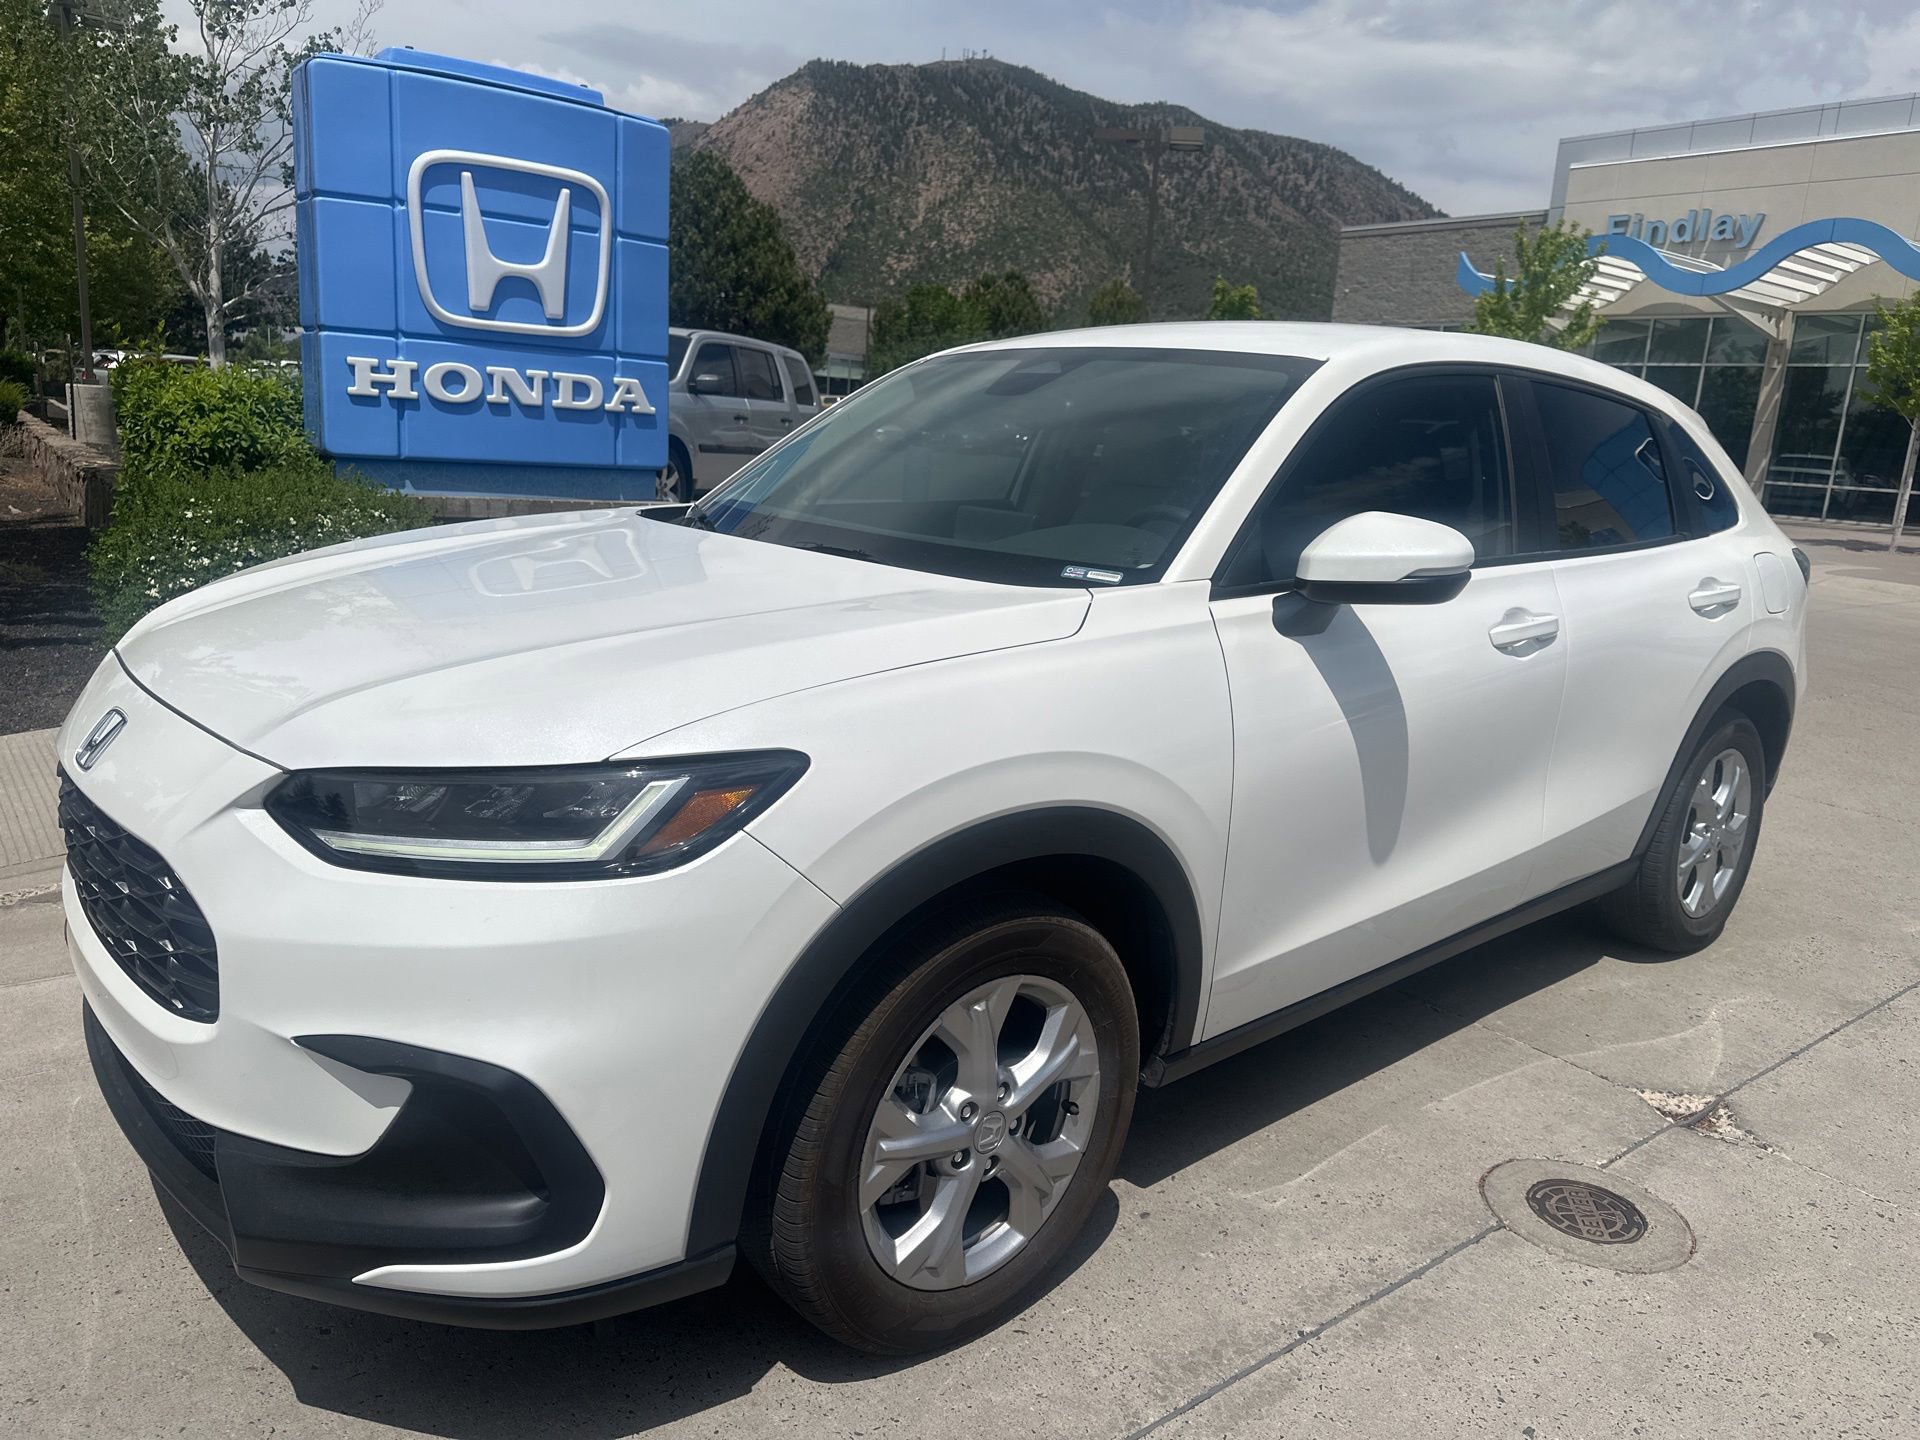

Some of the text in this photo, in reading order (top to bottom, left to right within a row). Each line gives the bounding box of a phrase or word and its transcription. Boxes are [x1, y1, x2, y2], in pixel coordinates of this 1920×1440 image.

[1606, 208, 1766, 248] Findlay
[346, 356, 656, 415] HONDA
[1567, 1190, 1605, 1237] SEWER
